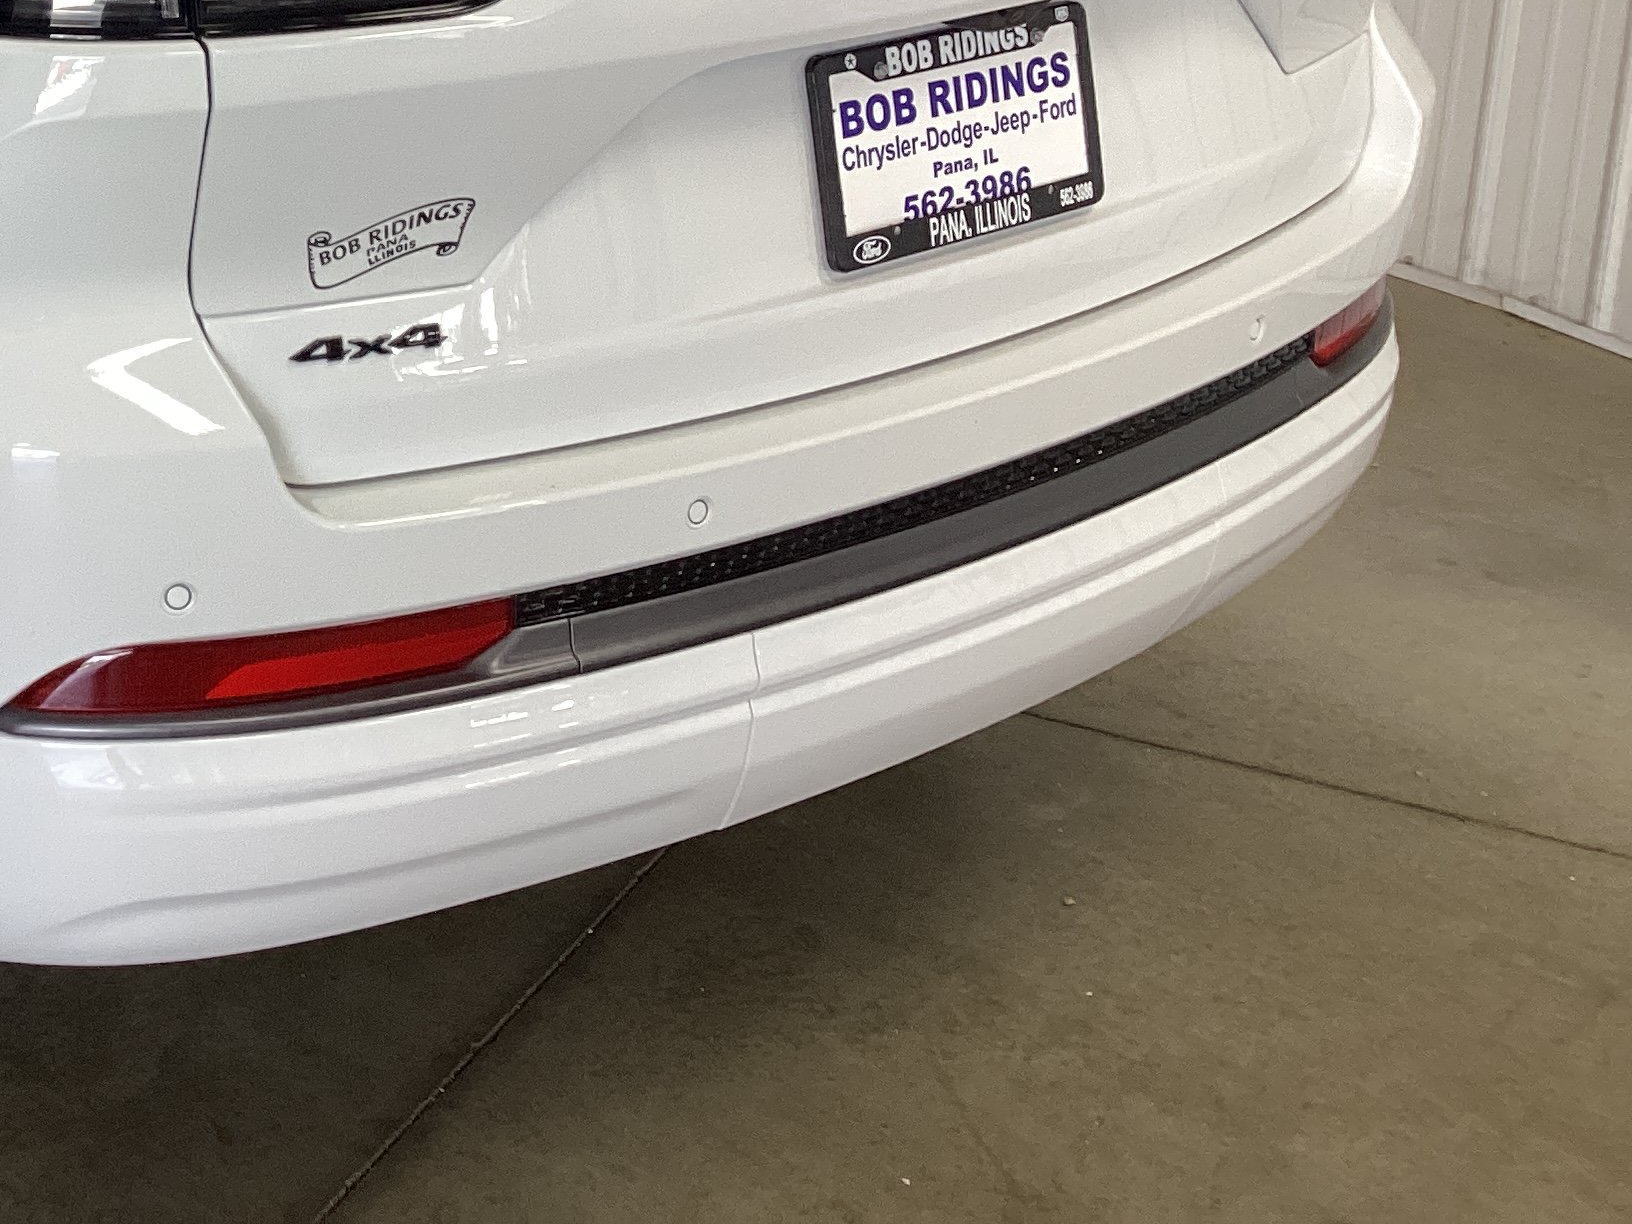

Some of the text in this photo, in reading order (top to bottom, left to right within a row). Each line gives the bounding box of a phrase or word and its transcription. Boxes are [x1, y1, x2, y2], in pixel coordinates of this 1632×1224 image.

[884, 24, 1029, 77] BOB RIDINGS
[839, 51, 1072, 139] BOB RIDINGS
[842, 93, 1078, 172] Chrysler-Dodge-Jeep-Ford
[933, 148, 1000, 178] Pana, IL
[903, 166, 1032, 221] 562-3986
[975, 192, 1032, 234] ILLINOIS
[319, 202, 464, 266] BOB RIDINGS
[288, 322, 449, 363] 4x4
